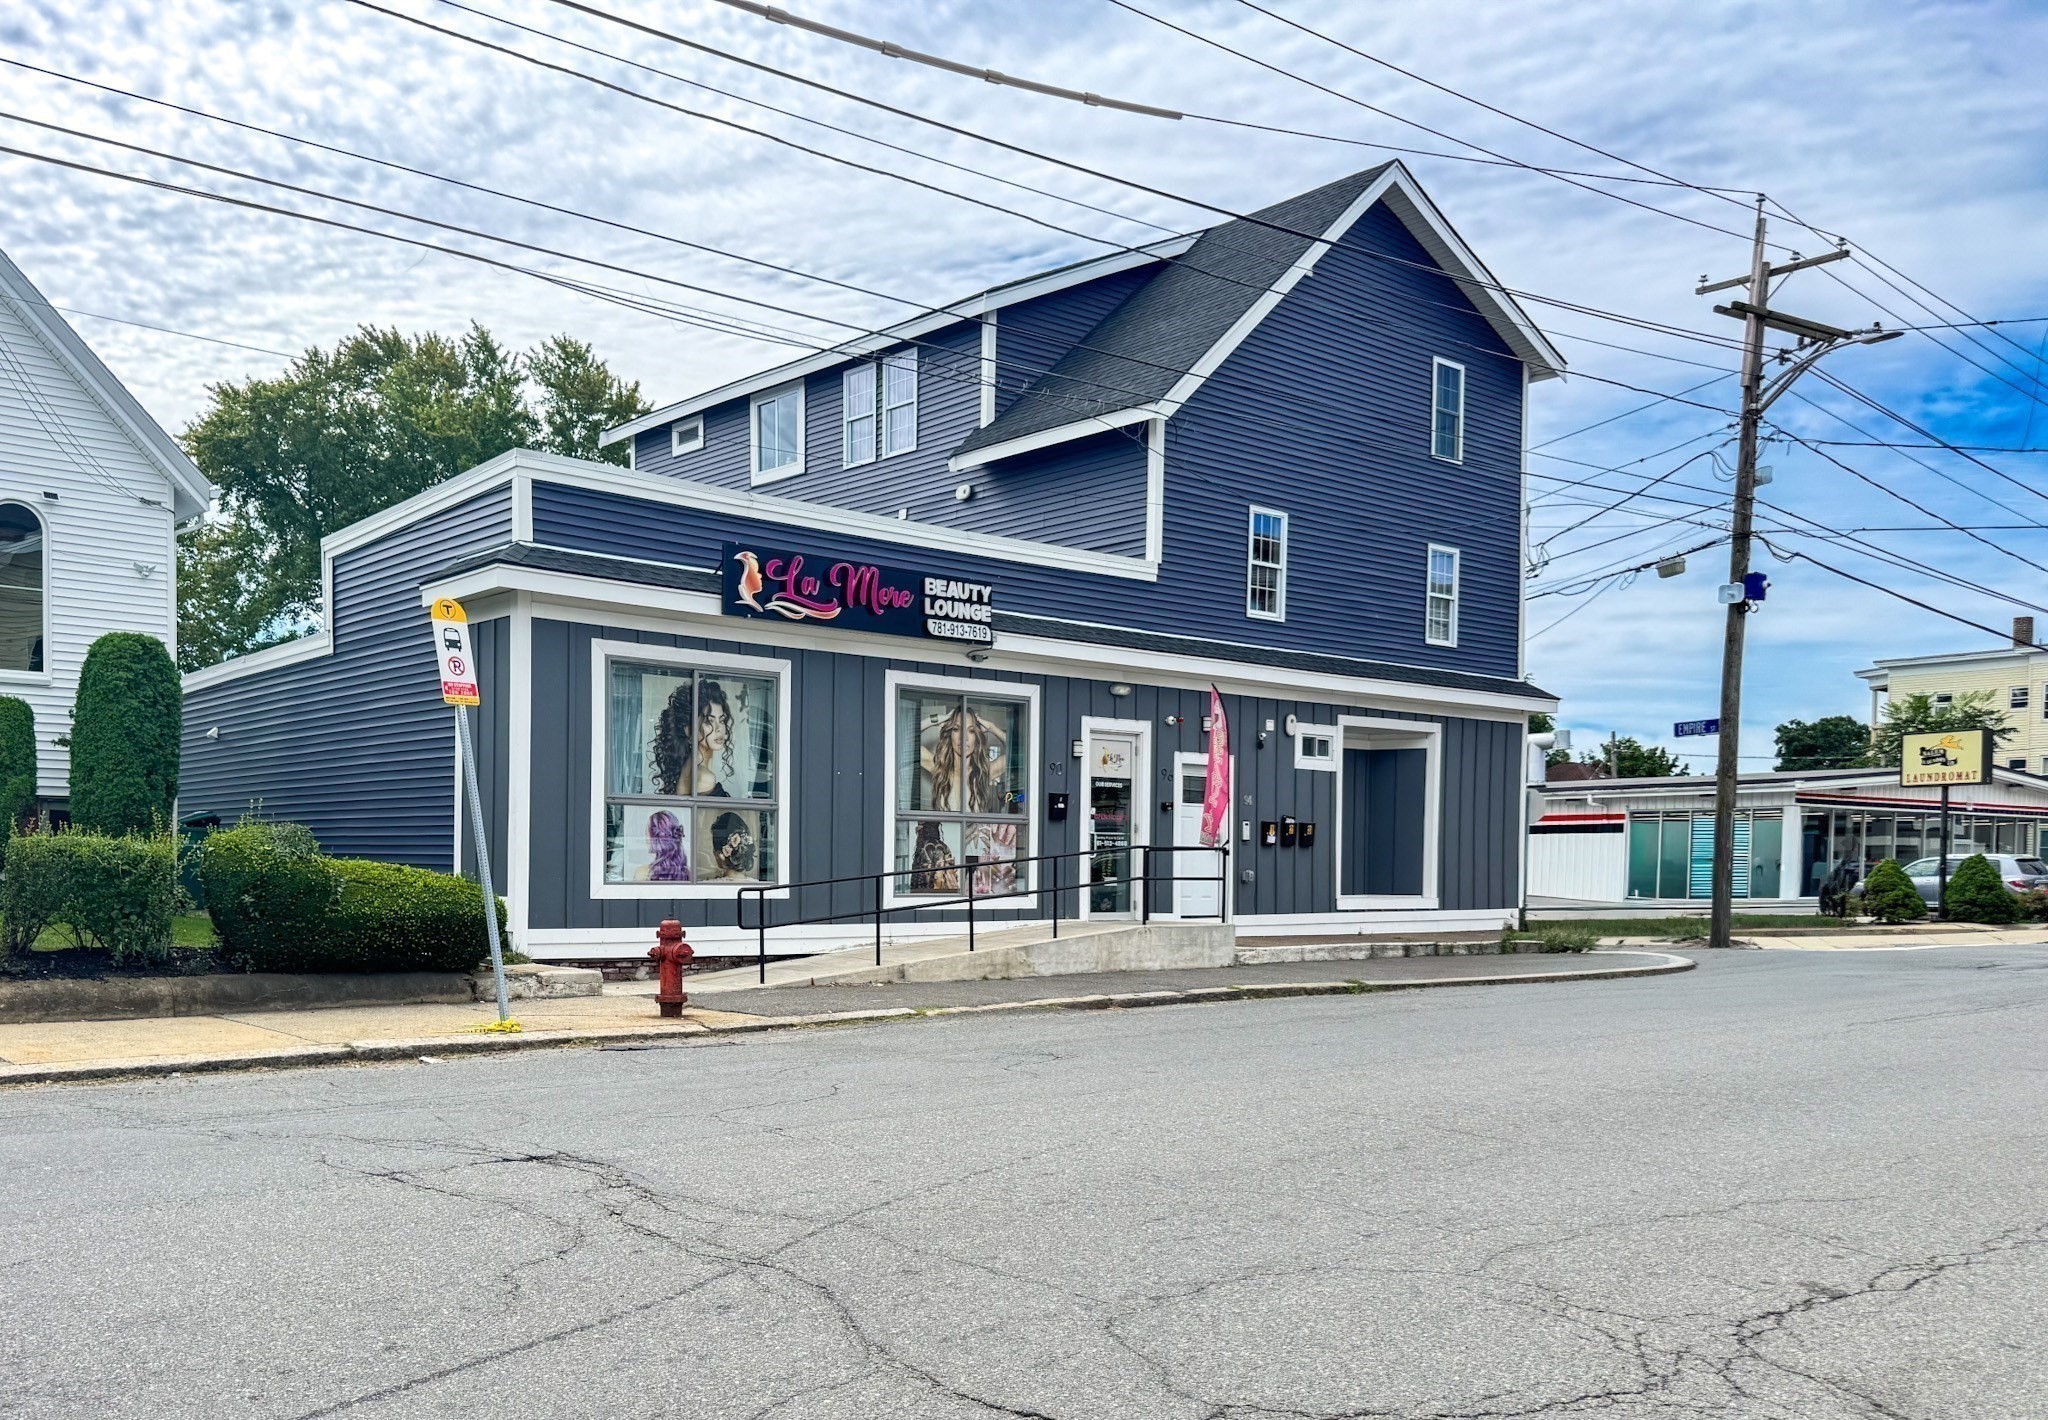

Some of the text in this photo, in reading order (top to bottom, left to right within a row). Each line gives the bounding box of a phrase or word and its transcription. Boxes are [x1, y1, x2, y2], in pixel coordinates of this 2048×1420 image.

[766, 555, 914, 615] La More
[925, 577, 992, 603] BEAUTY
[442, 604, 453, 615] T
[925, 597, 992, 622] LOUNGE
[932, 621, 987, 639] 781-913-7619
[1677, 722, 1706, 736] EMPIRE
[1160, 767, 1174, 782] 96
[1906, 770, 1977, 783] LAUNDROMAT
